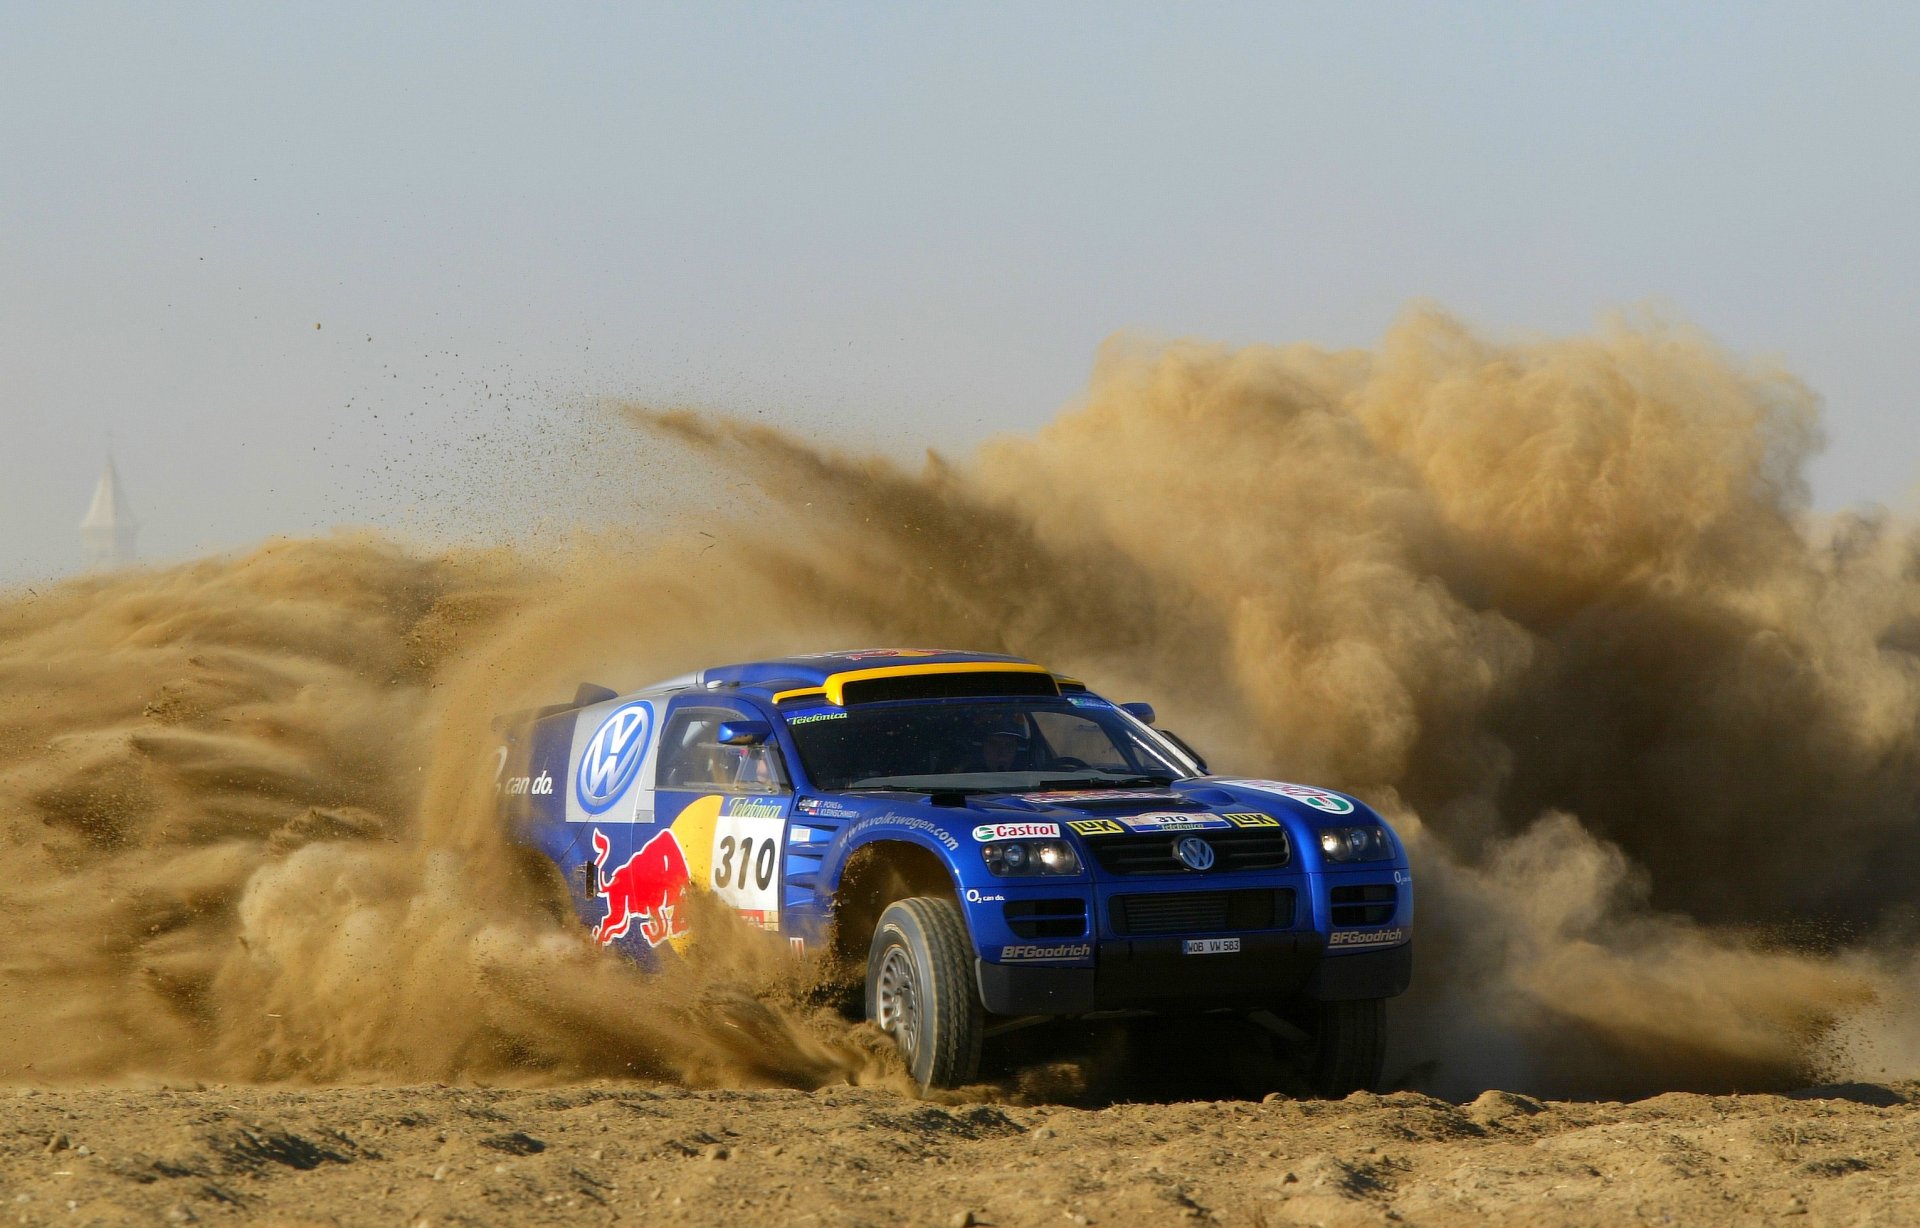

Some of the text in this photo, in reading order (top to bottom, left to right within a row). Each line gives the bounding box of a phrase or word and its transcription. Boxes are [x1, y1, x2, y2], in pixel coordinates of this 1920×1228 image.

[532, 770, 553, 795] do.
[1156, 815, 1188, 823] 310
[839, 811, 960, 851] www.volkswagen.com
[996, 824, 1057, 838] Castrol
[715, 835, 776, 891] 310
[1329, 929, 1402, 945] BFGoodrich
[1001, 944, 1090, 959] BFGoodrich
[1187, 940, 1239, 953] WOB VW 583
